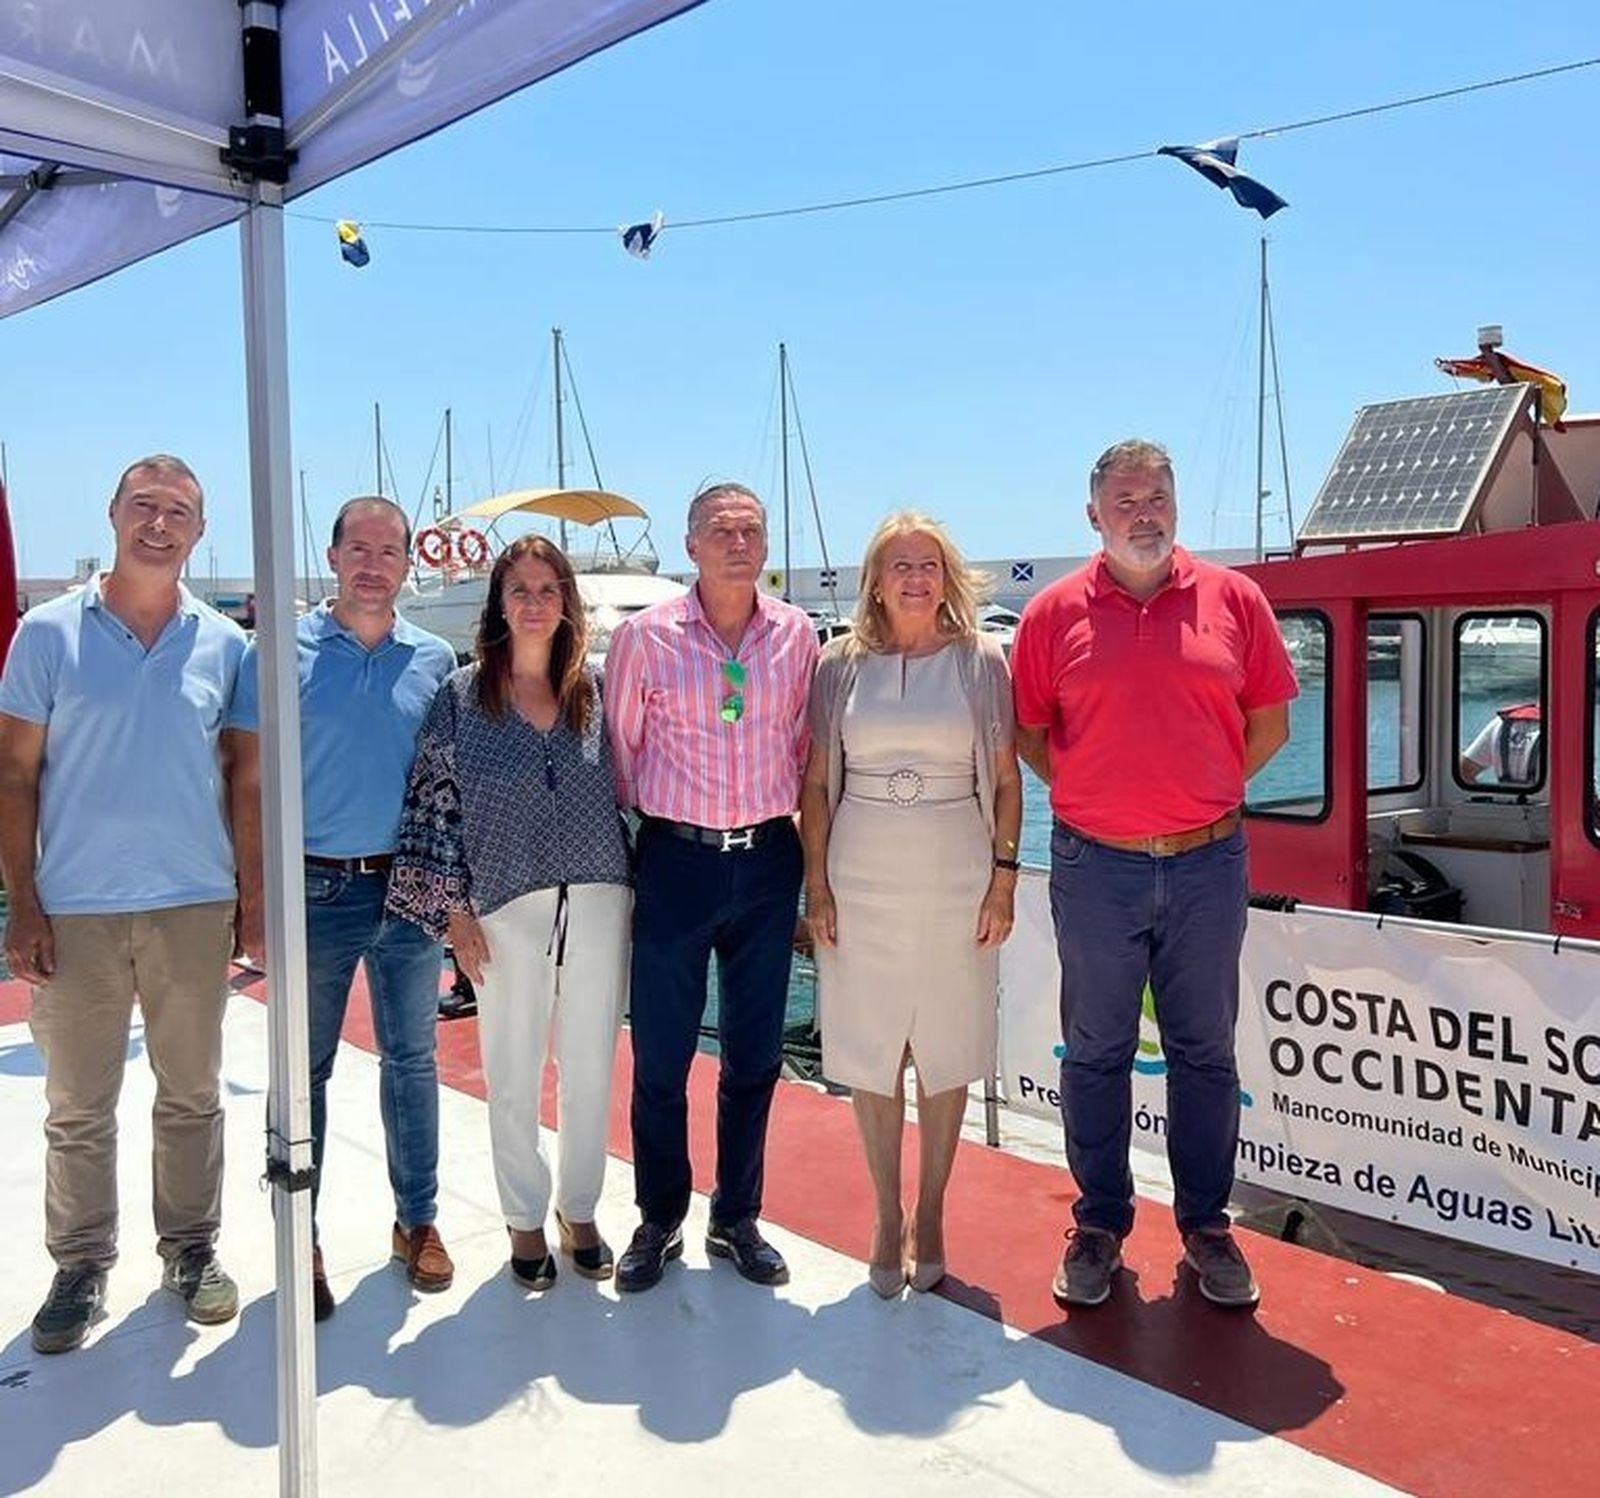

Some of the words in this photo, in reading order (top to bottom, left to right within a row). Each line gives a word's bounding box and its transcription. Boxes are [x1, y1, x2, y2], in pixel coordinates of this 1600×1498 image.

[1265, 979, 1417, 1042] COSTA
[1429, 1007, 1528, 1065] DEL
[1544, 1027, 1600, 1086] SO
[1272, 1092, 1463, 1147] Mancomunidad
[1472, 1132, 1501, 1157] de
[1354, 1164, 1395, 1198] de
[1407, 1174, 1533, 1231] Aguas
[1546, 1207, 1600, 1248] Lit
